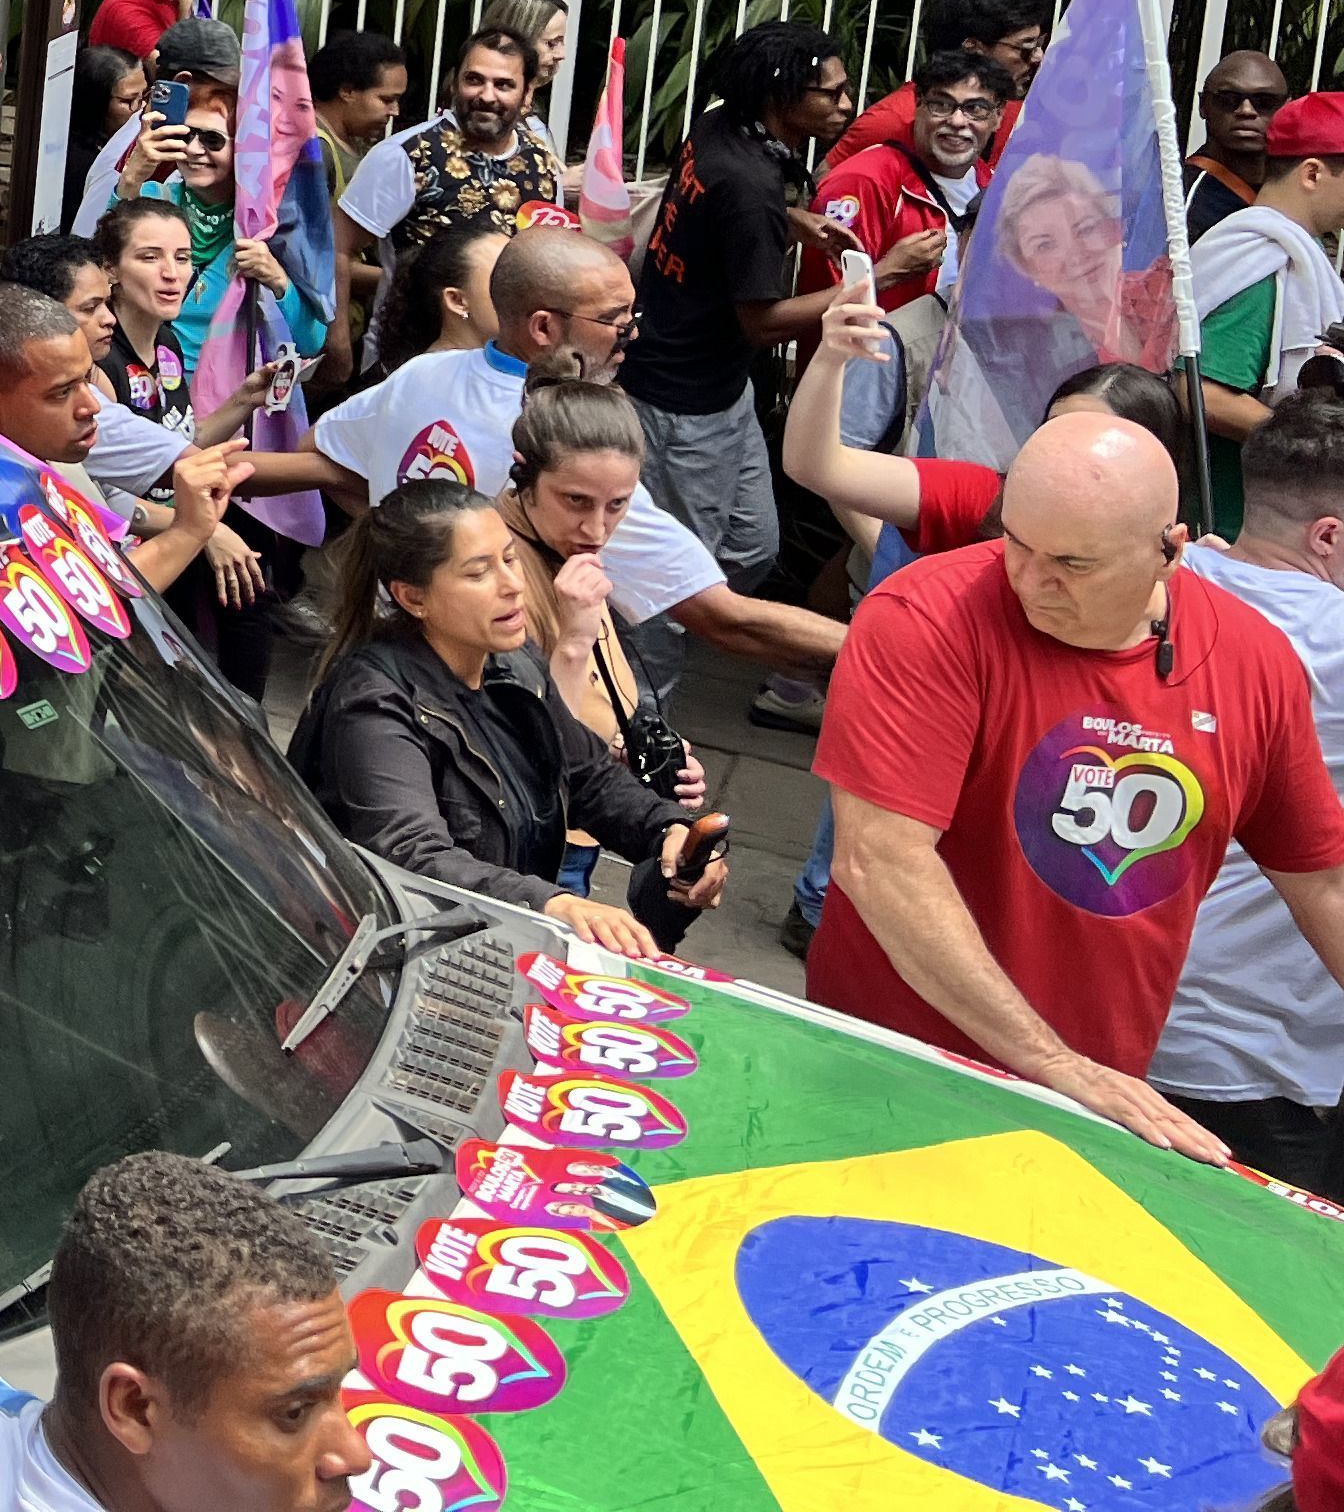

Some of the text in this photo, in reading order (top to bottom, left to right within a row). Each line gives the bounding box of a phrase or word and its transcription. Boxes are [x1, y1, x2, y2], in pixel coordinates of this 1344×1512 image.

[825, 196, 859, 222] 50
[427, 424, 460, 458] VOTE
[22, 514, 55, 548] VOTE
[50, 550, 111, 616] 50
[3, 575, 70, 654] 50
[1082, 716, 1143, 736] BOULOS
[1106, 732, 1175, 755] MARTA
[1073, 766, 1114, 787] VOTE
[1051, 764, 1183, 850] 50
[526, 952, 566, 991] VOTE
[574, 979, 655, 1019] 50
[527, 1006, 562, 1057] VOTE
[579, 1026, 658, 1074] 50
[503, 1073, 547, 1123] VOTE
[559, 1086, 649, 1142] 50
[425, 1223, 480, 1281] VOTE
[485, 1236, 587, 1308] 50
[396, 1311, 508, 1403] 50
[846, 1339, 908, 1421] ORDEM
[909, 1276, 1086, 1333] PROGRESSO
[345, 1416, 463, 1512] 50
